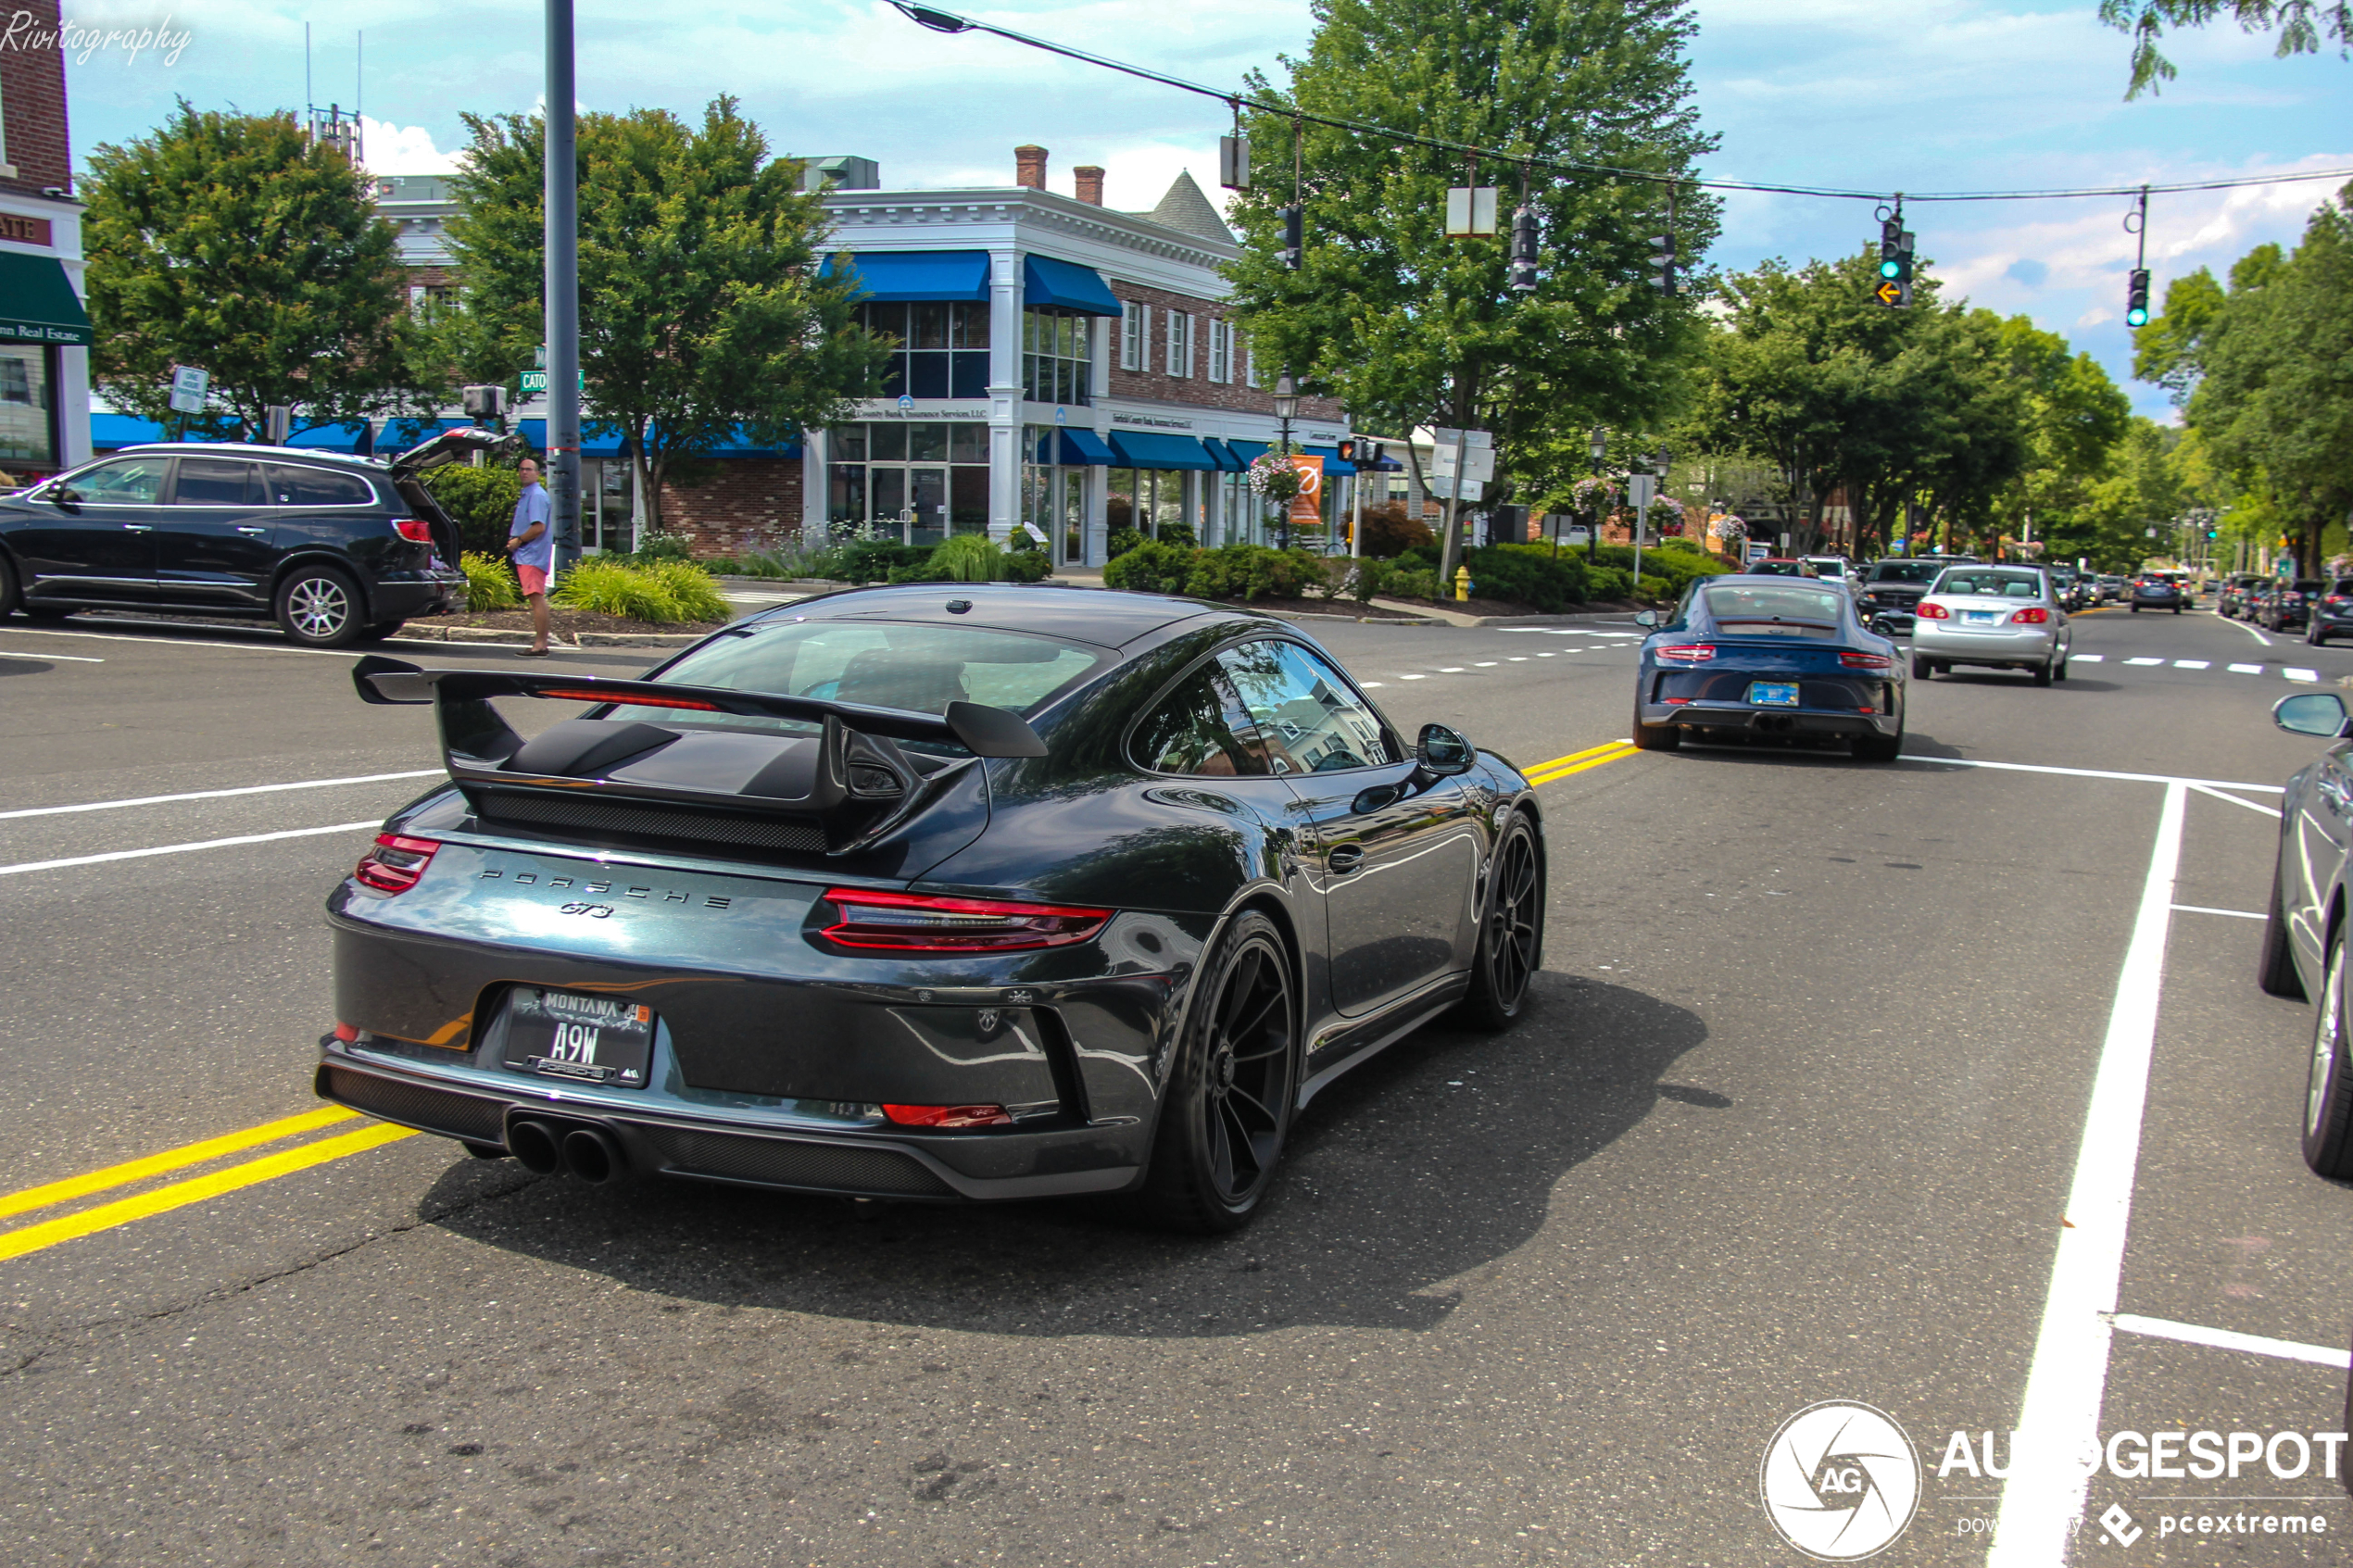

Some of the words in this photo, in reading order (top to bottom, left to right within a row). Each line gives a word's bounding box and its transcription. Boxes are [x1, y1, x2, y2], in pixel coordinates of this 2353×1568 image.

[19, 325, 44, 338] Real
[47, 328, 81, 342] Estate
[479, 869, 731, 909] PORSCHE
[560, 901, 614, 918] GT3
[545, 993, 618, 1017] MONTANA
[551, 1022, 599, 1064] A9W
[537, 1061, 604, 1078] PORSCHE
